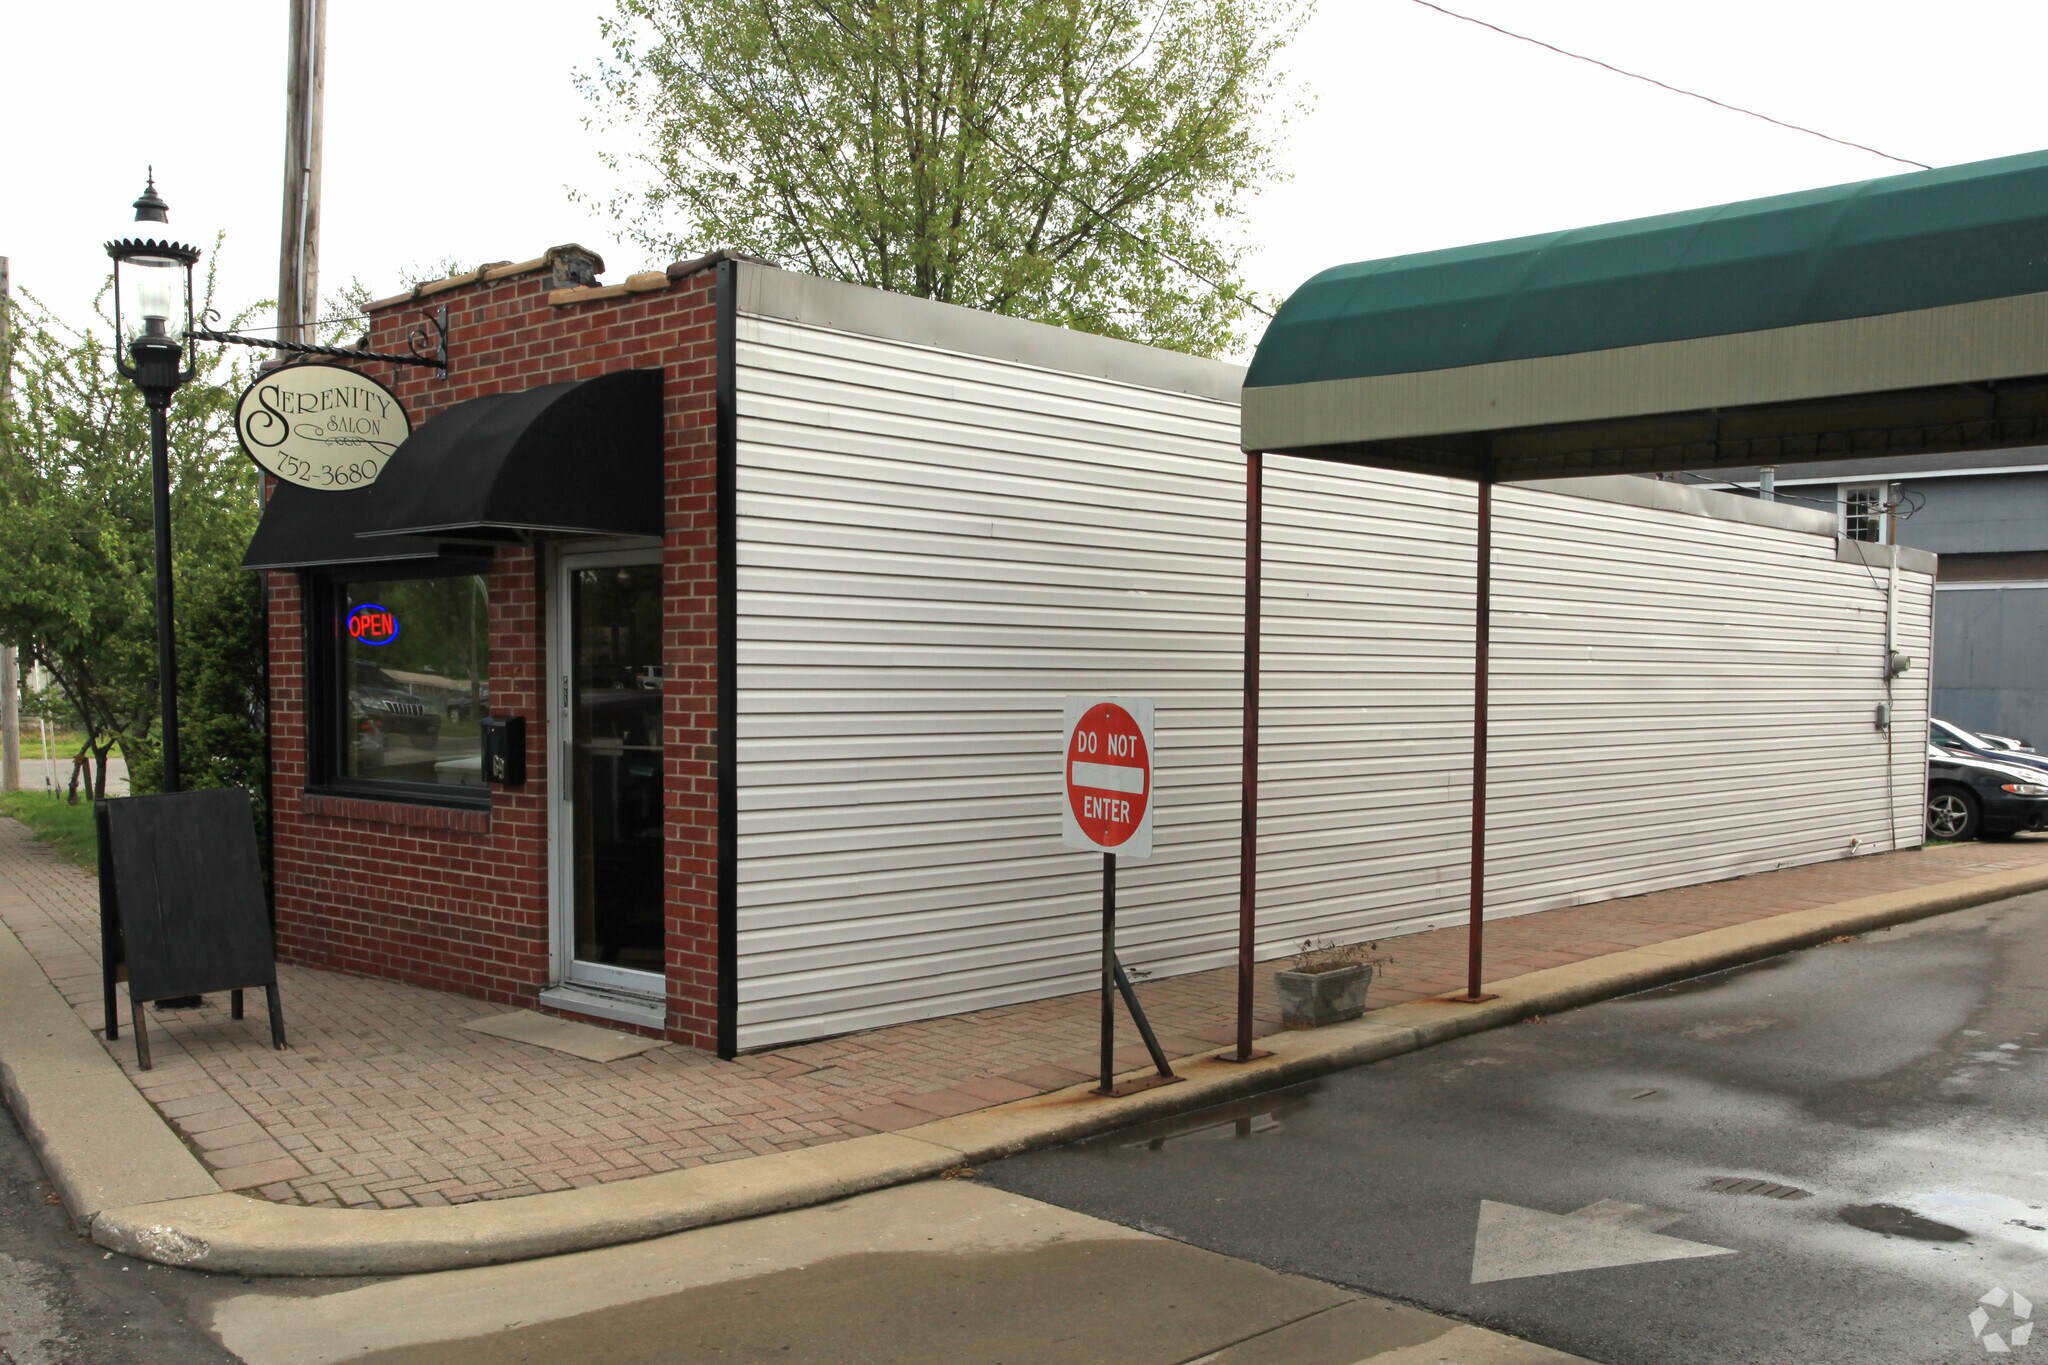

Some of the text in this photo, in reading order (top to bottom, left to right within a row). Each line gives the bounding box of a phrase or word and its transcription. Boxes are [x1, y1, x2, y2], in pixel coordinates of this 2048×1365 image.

[246, 384, 391, 448] SERENITY
[327, 415, 380, 435] SALON
[277, 450, 378, 486] 752-3680
[350, 613, 393, 637] OPEN
[1077, 730, 1137, 758] DO NOT
[1083, 795, 1130, 824] ENTER
